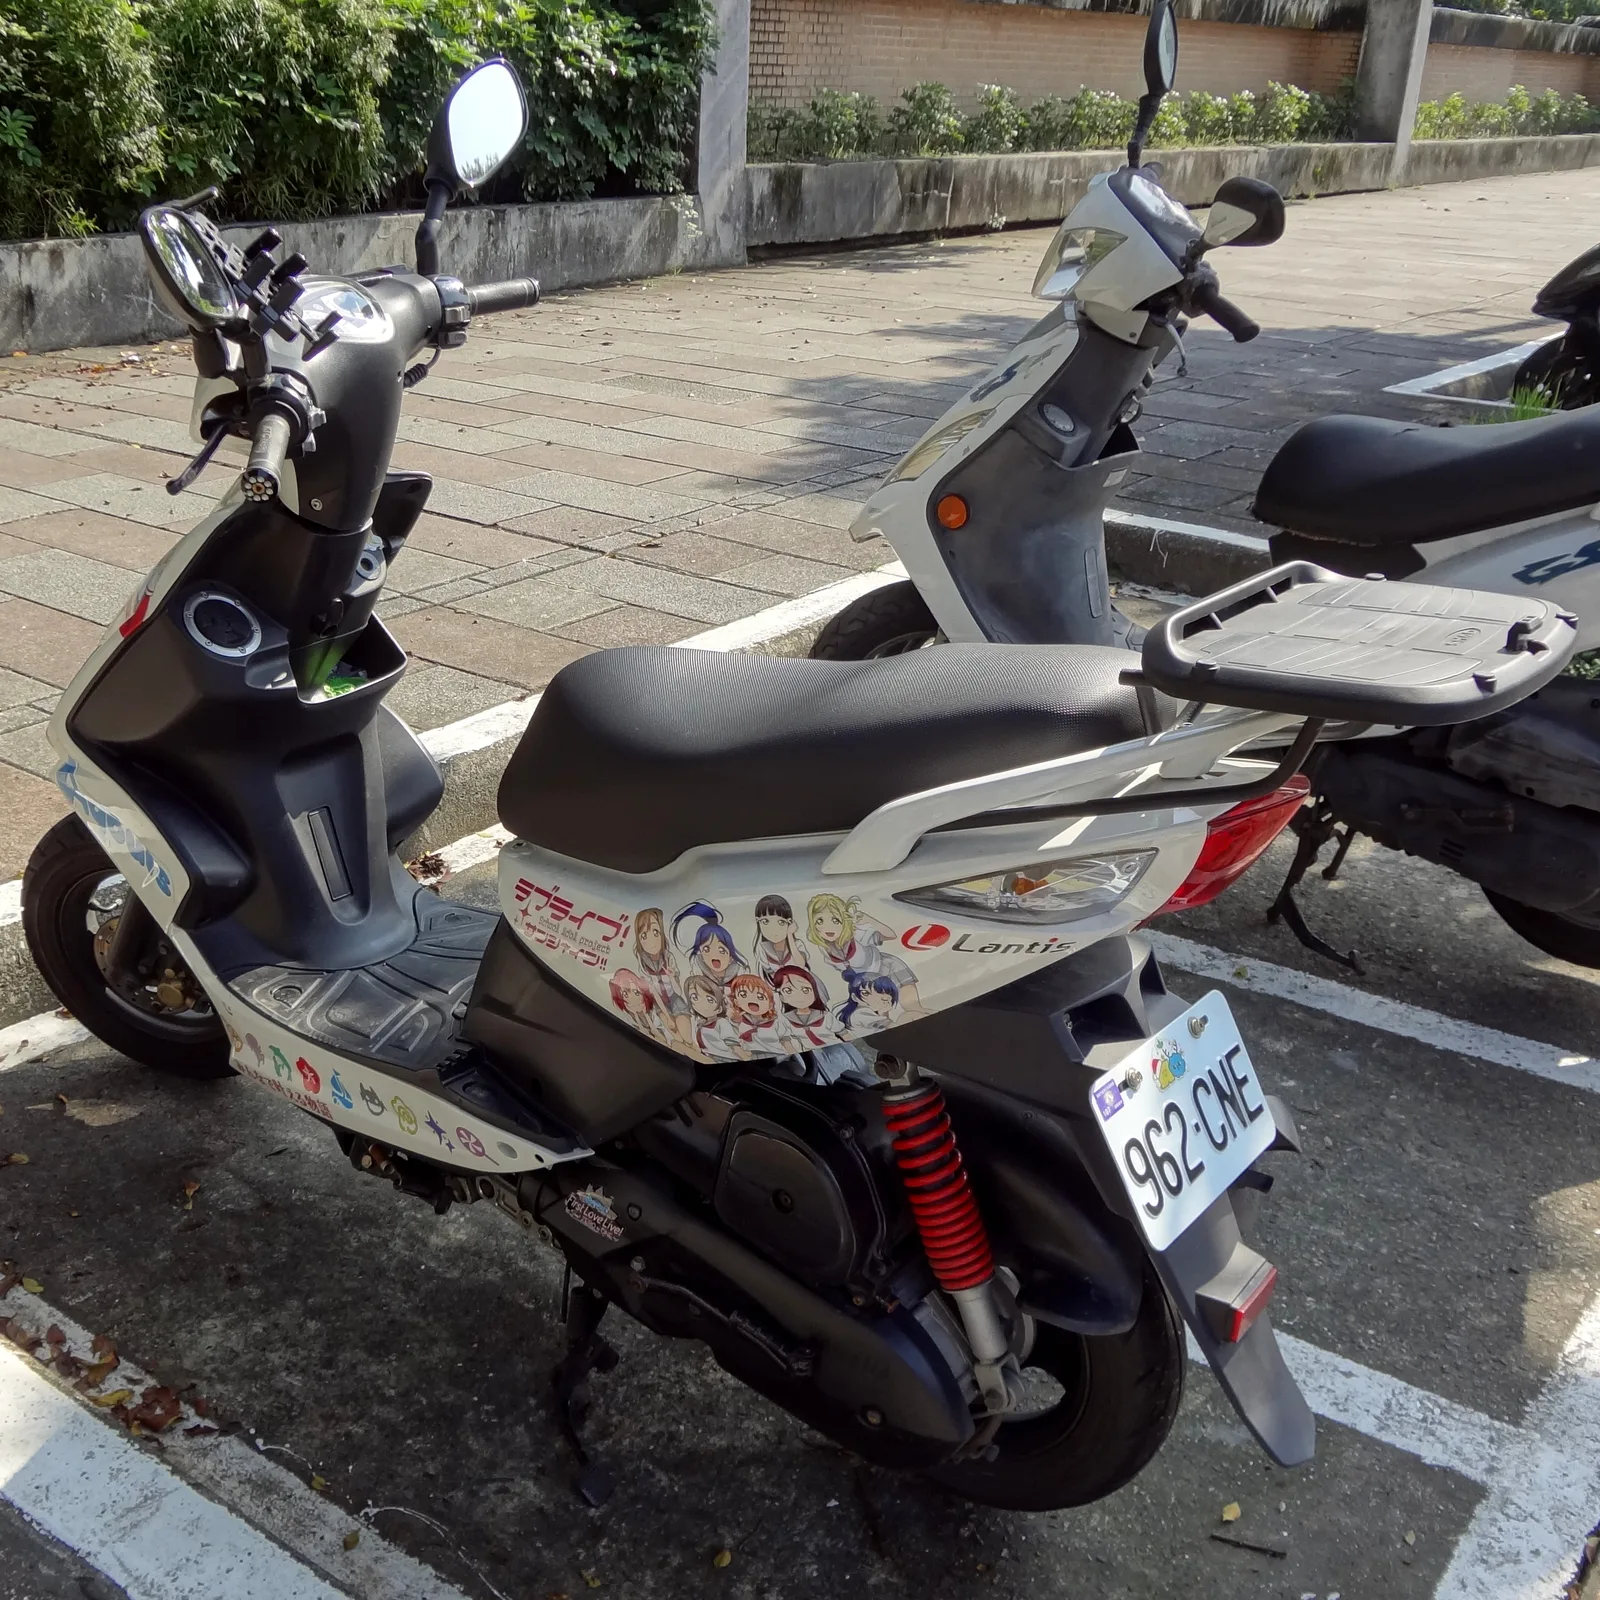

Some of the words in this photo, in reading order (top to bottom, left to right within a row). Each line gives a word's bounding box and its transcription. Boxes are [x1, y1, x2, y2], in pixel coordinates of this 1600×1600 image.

[515, 877, 631, 947] ラブライブ!
[561, 926, 578, 944] idol
[579, 936, 611, 955] project
[951, 933, 1077, 955] Lantis
[567, 1193, 585, 1212] First
[583, 1206, 603, 1224] Love
[602, 1218, 624, 1236] Live!
